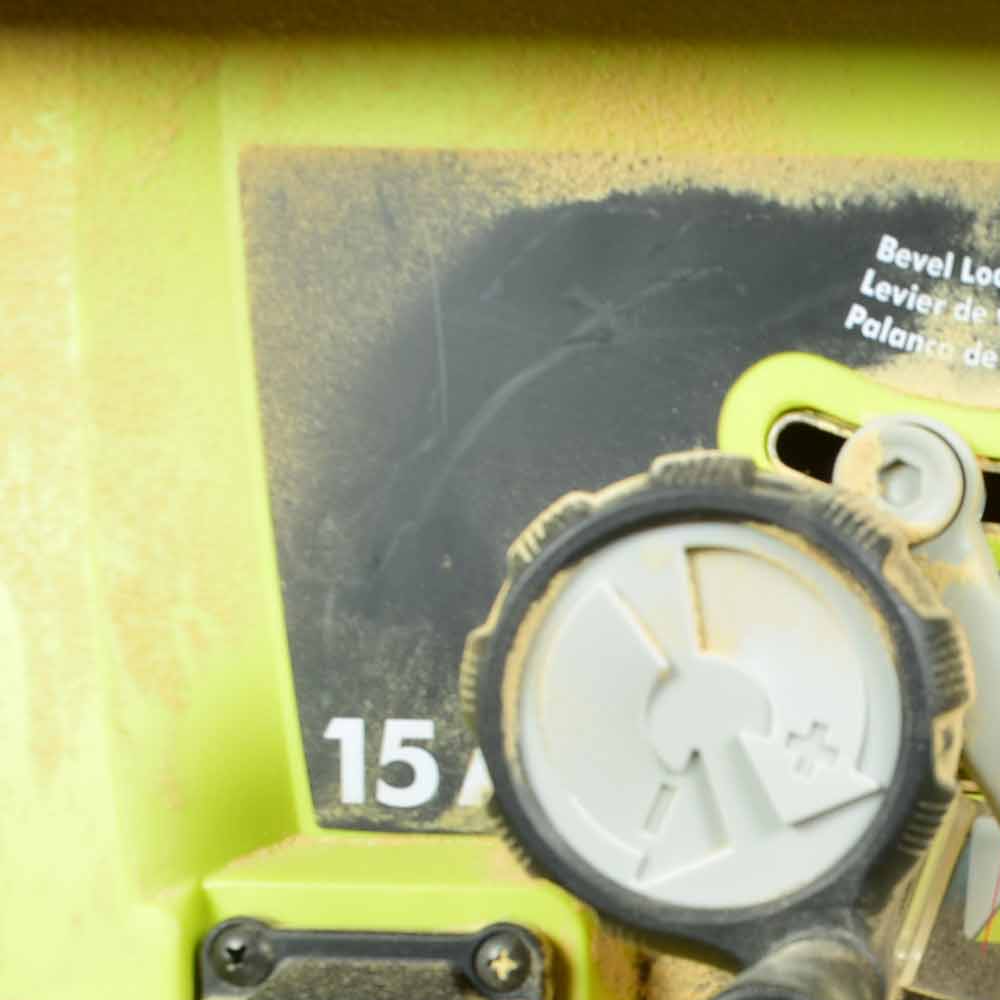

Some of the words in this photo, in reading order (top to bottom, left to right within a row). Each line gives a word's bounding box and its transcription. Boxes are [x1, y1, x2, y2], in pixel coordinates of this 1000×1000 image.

[876, 234, 954, 279] Bevel
[860, 268, 948, 317] Levier
[954, 292, 987, 324] de
[963, 340, 998, 369] de
[323, 717, 440, 808] 15
